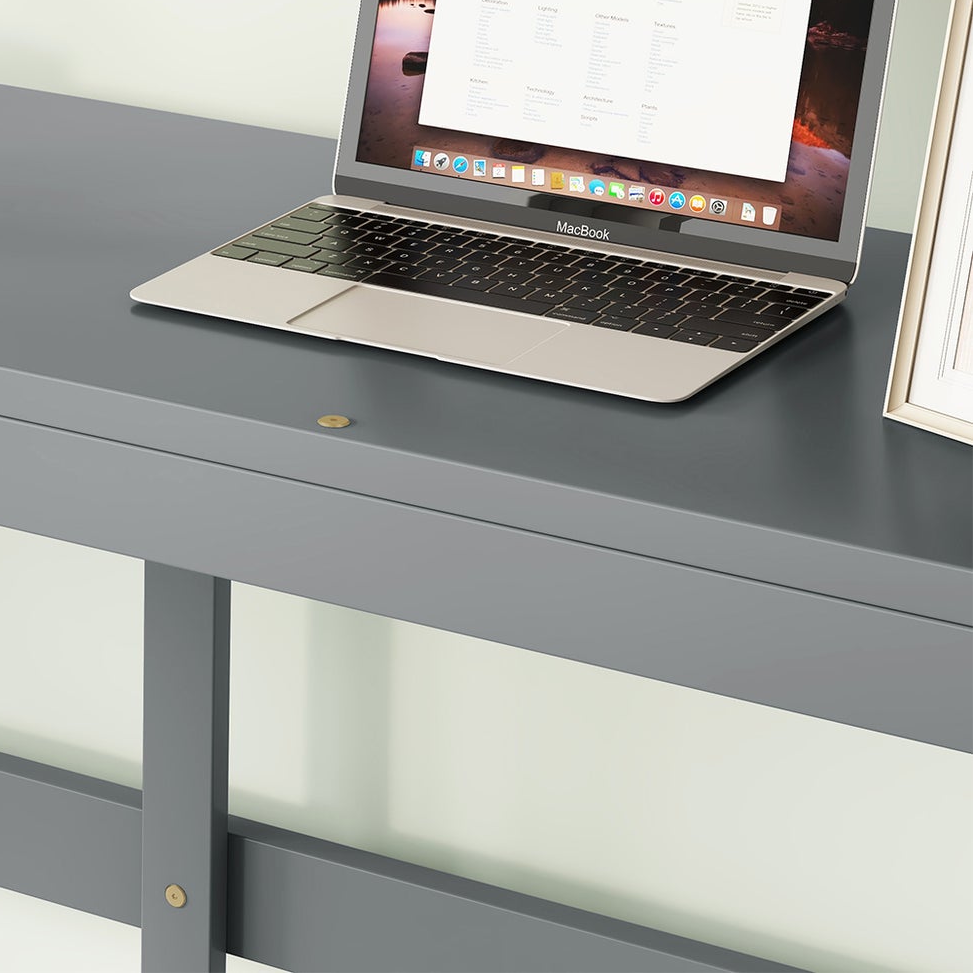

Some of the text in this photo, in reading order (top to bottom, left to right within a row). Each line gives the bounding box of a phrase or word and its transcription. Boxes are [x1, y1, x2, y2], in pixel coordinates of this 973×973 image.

[537, 5, 558, 13] Lighting
[654, 20, 676, 29] Textures
[469, 77, 488, 85] Kitchen
[526, 86, 555, 96] Technology
[583, 94, 614, 104] Architecture
[641, 103, 658, 111] Plants
[556, 220, 610, 241] MacBook
